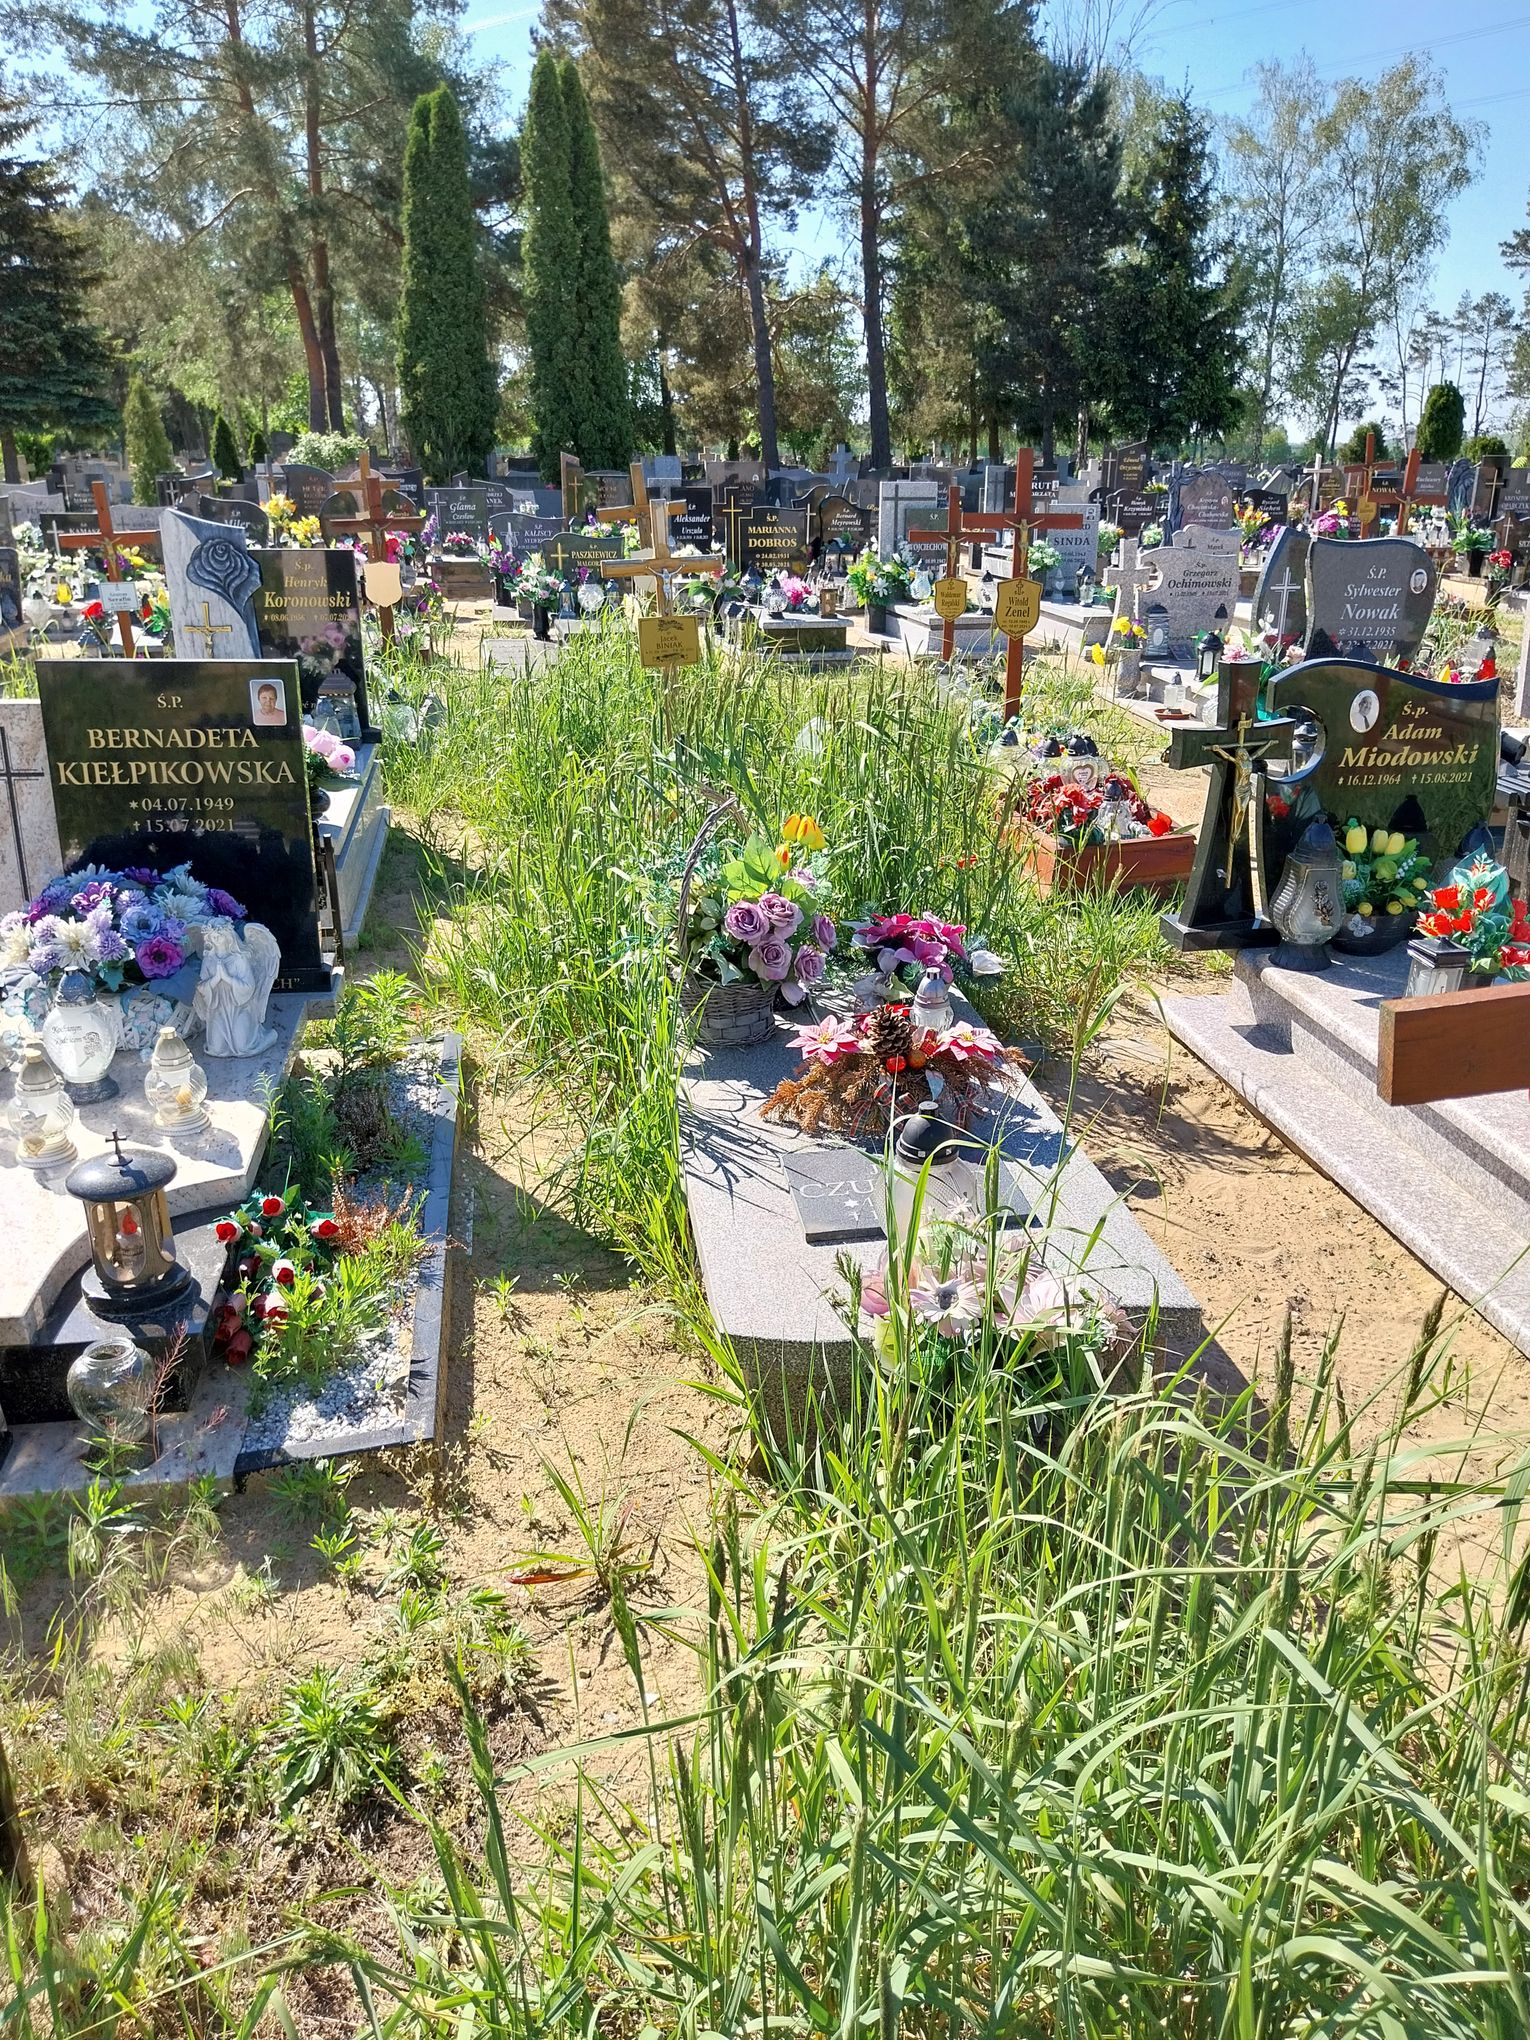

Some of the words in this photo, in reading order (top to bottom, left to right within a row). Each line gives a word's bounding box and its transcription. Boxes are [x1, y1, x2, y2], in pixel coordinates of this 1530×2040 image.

[449, 501, 477, 513] Glama
[674, 514, 711, 524] Aleksander
[747, 526, 798, 534] MARIANNA
[748, 538, 798, 548] DOBROS
[1053, 537, 1091, 546] SINDA
[570, 550, 618, 559] PASZKIEWICZ
[1182, 569, 1218, 579] Grzegorz
[1366, 564, 1387, 579] Ś.P.
[283, 576, 328, 589] Henryk
[1167, 577, 1232, 589] Ochimowski
[1344, 583, 1403, 600] Sylwester
[263, 591, 351, 609] Koronowski
[1008, 596, 1029, 607] Witold
[1005, 605, 1030, 618] Zenel
[1340, 603, 1401, 620] Nowak
[656, 641, 683, 650] BINIAK
[157, 693, 183, 710] Ś.P.
[1382, 723, 1443, 740] Adam
[86, 728, 261, 749] BERNADETA
[1338, 743, 1480, 768] Miodowski
[56, 760, 297, 786] KIEŁPIKOWSKA
